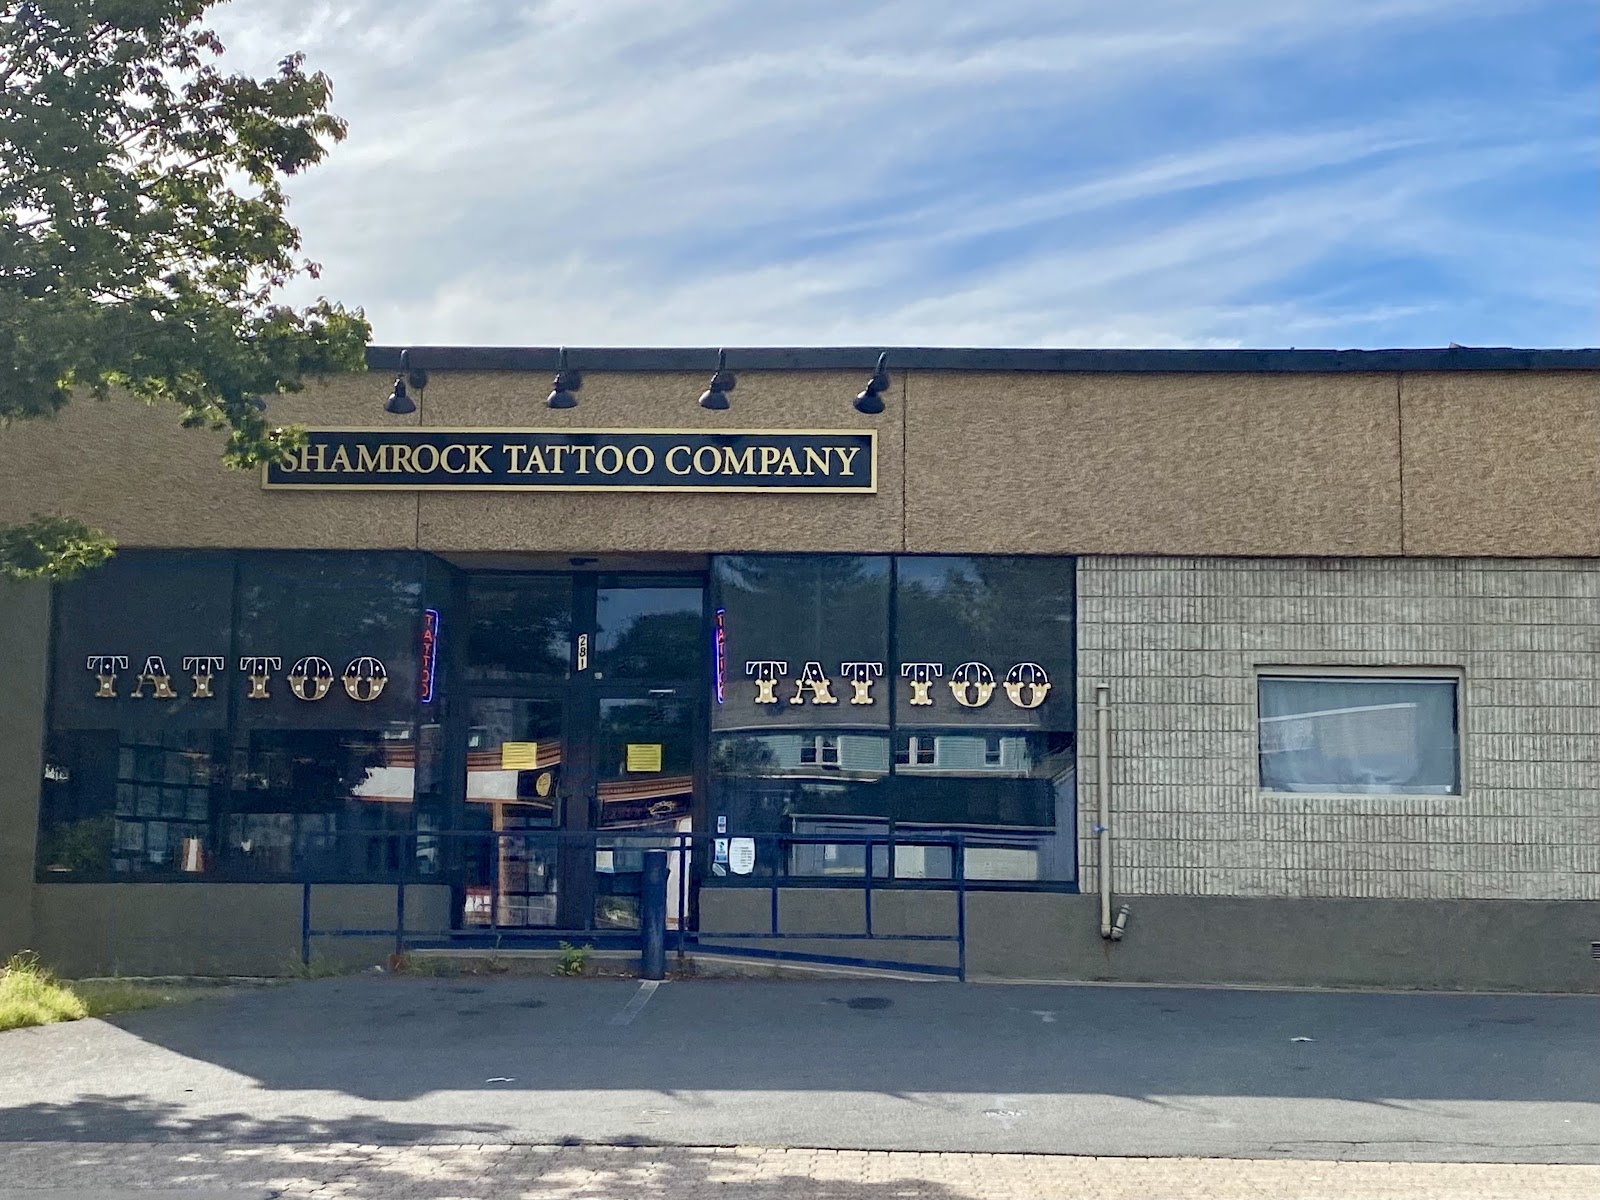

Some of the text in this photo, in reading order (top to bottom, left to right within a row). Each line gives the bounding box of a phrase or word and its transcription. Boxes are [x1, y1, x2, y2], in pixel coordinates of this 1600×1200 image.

[278, 443, 861, 478] SHAMROCK TATTOO COMPANY
[87, 655, 388, 701] TATTOO
[745, 660, 1052, 708] TATTOO
